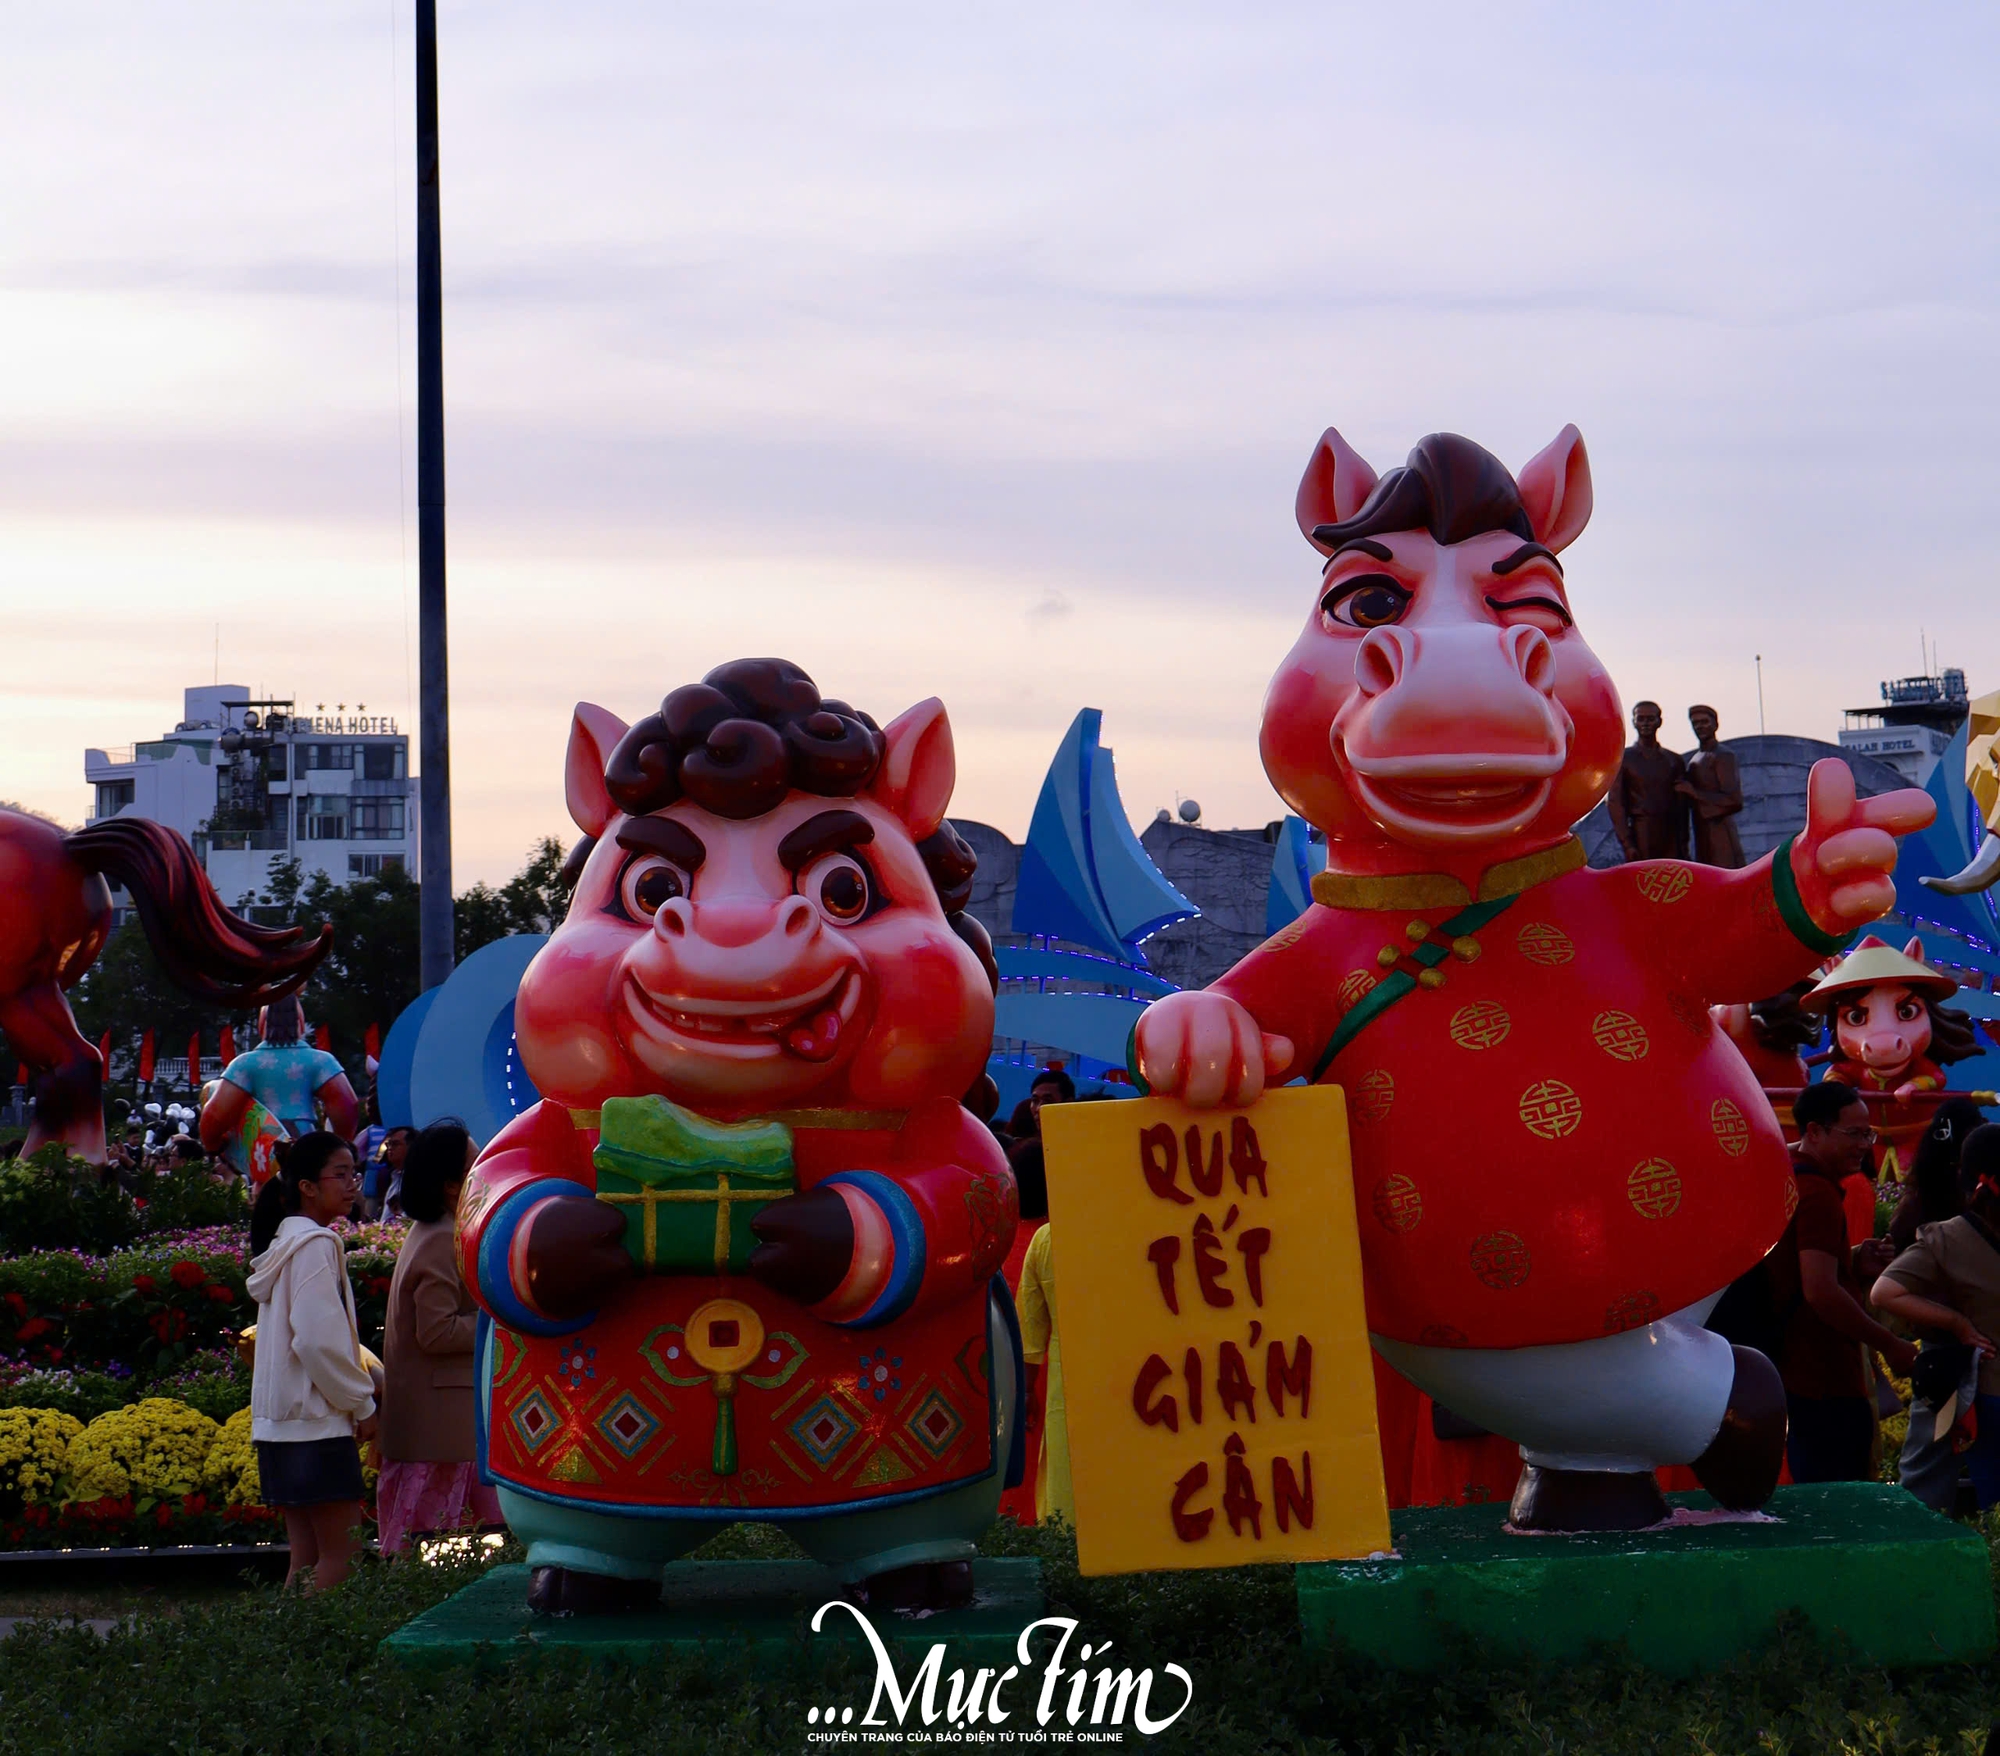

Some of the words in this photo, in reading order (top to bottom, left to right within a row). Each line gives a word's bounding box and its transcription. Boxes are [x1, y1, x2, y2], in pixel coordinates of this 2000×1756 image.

[348, 717, 396, 734] HOTEL
[1882, 739, 1915, 751] HOTEL
[1140, 1116, 1268, 1205] QUA
[1147, 1203, 1271, 1315] TẾT
[1132, 1320, 1312, 1433] GIẢM
[1171, 1431, 1313, 1542] CÂN
